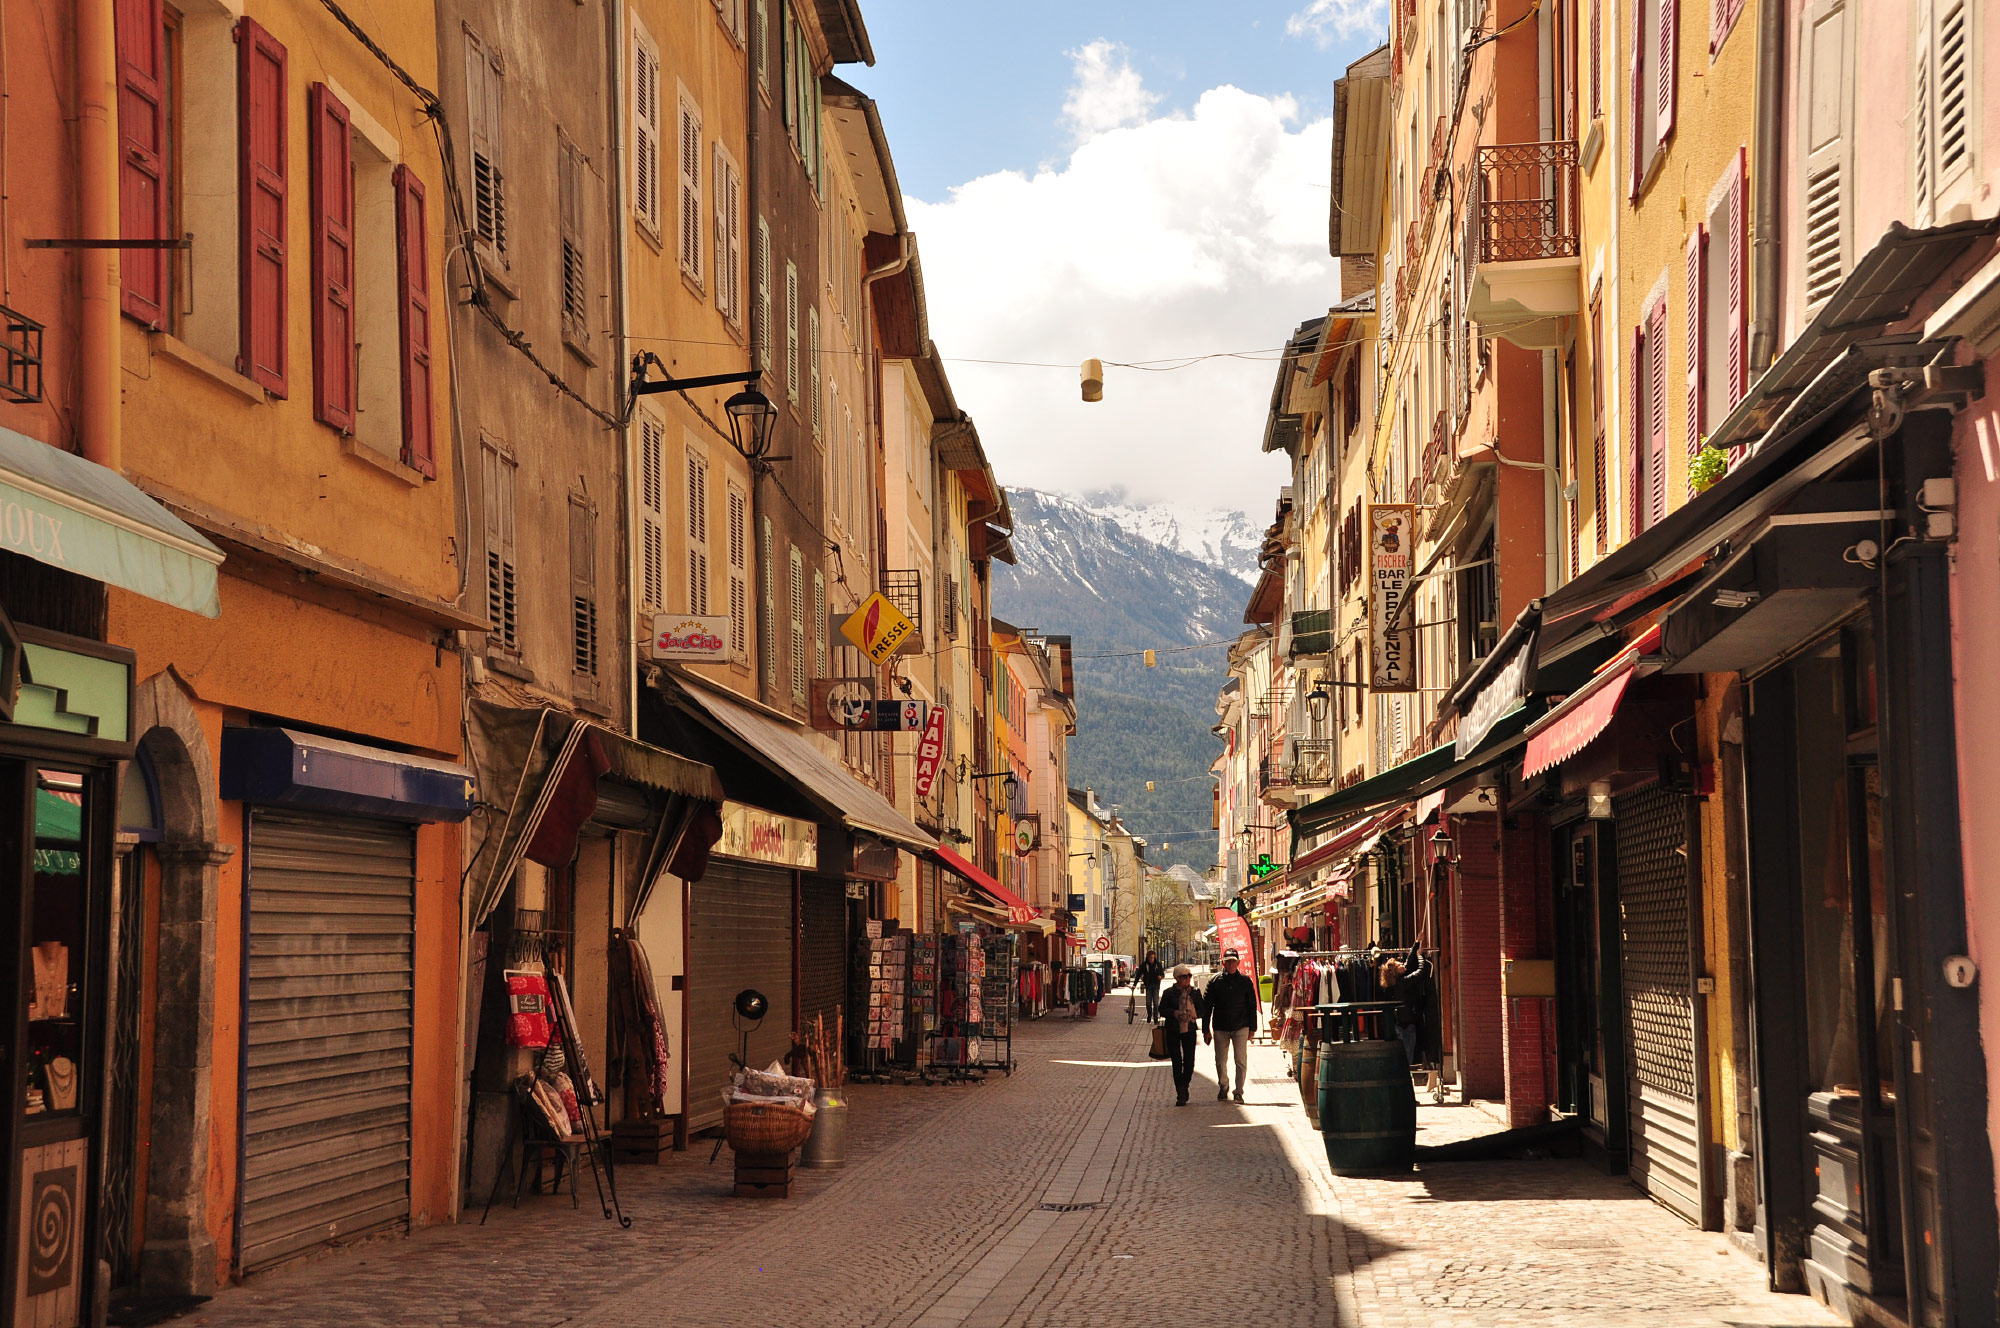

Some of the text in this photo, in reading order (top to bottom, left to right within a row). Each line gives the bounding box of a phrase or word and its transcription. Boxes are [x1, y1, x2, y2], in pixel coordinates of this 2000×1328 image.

[1377, 554, 1406, 568] FISCHER
[1378, 569, 1406, 579] BAR
[1382, 580, 1403, 590] LE
[870, 620, 909, 659] PRESSE
[916, 710, 943, 792] TABAC
